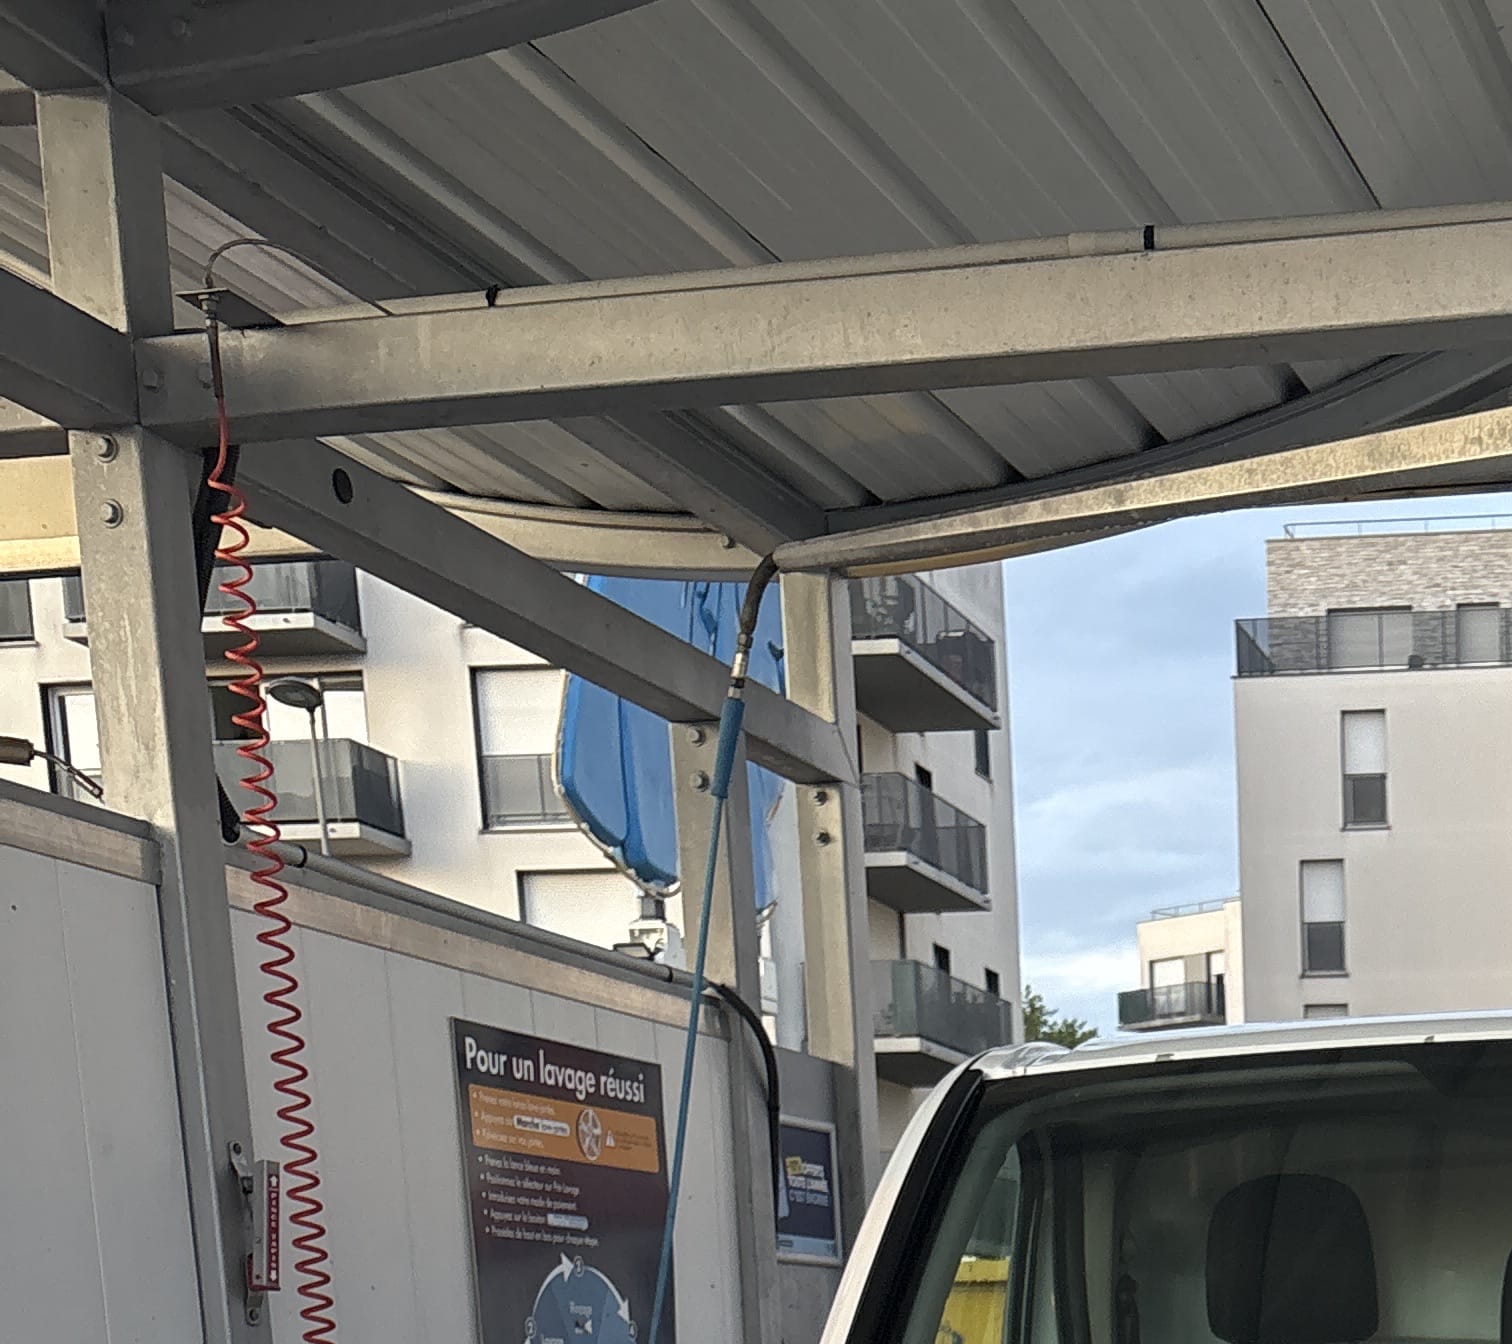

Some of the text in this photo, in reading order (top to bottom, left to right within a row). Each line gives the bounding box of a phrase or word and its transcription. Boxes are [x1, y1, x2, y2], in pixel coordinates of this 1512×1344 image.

[464, 1036, 507, 1075] Pour
[512, 1054, 534, 1081] un
[539, 1048, 596, 1101] lavage
[600, 1067, 645, 1103] réussi
